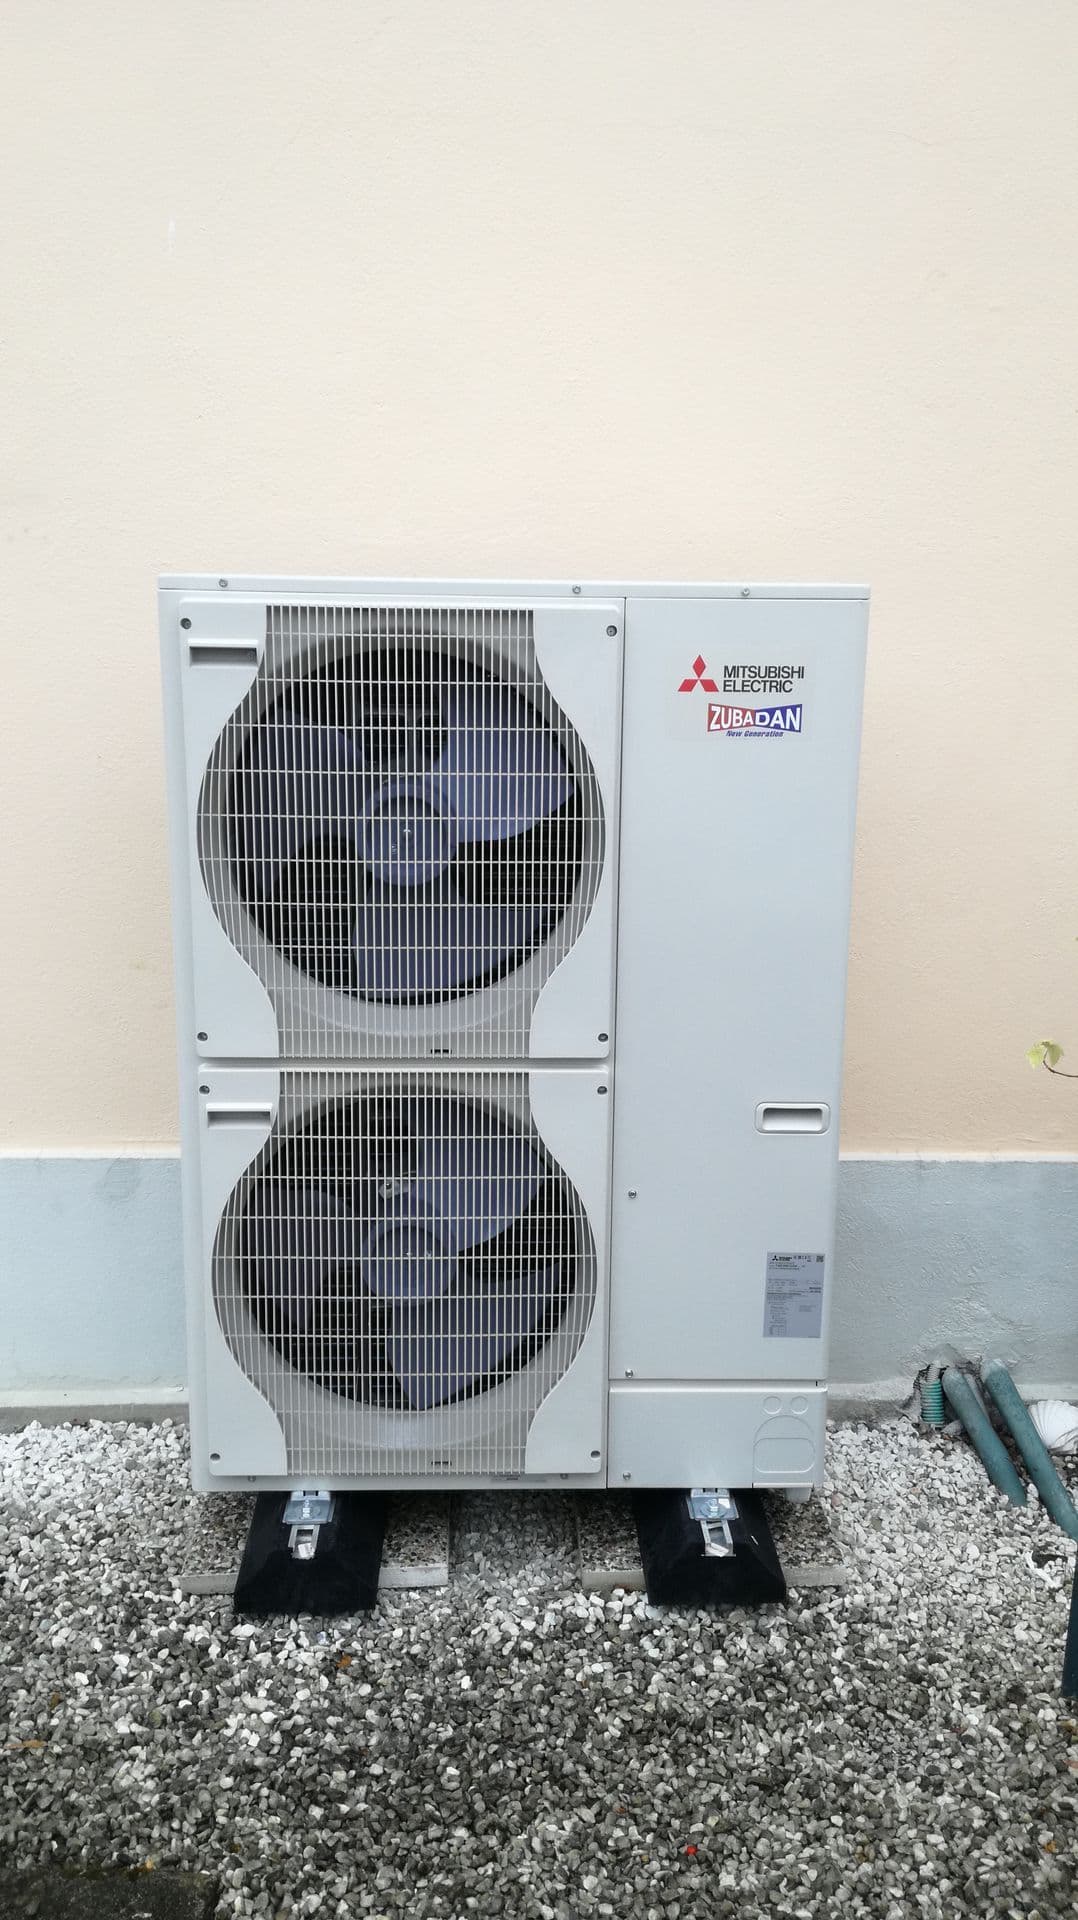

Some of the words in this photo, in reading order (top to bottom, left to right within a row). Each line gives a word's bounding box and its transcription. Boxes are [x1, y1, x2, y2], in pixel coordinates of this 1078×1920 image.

[723, 665, 804, 679] MITSUBISHI
[723, 679, 793, 693] ELECTRIC
[710, 706, 801, 730] ZUBADAN
